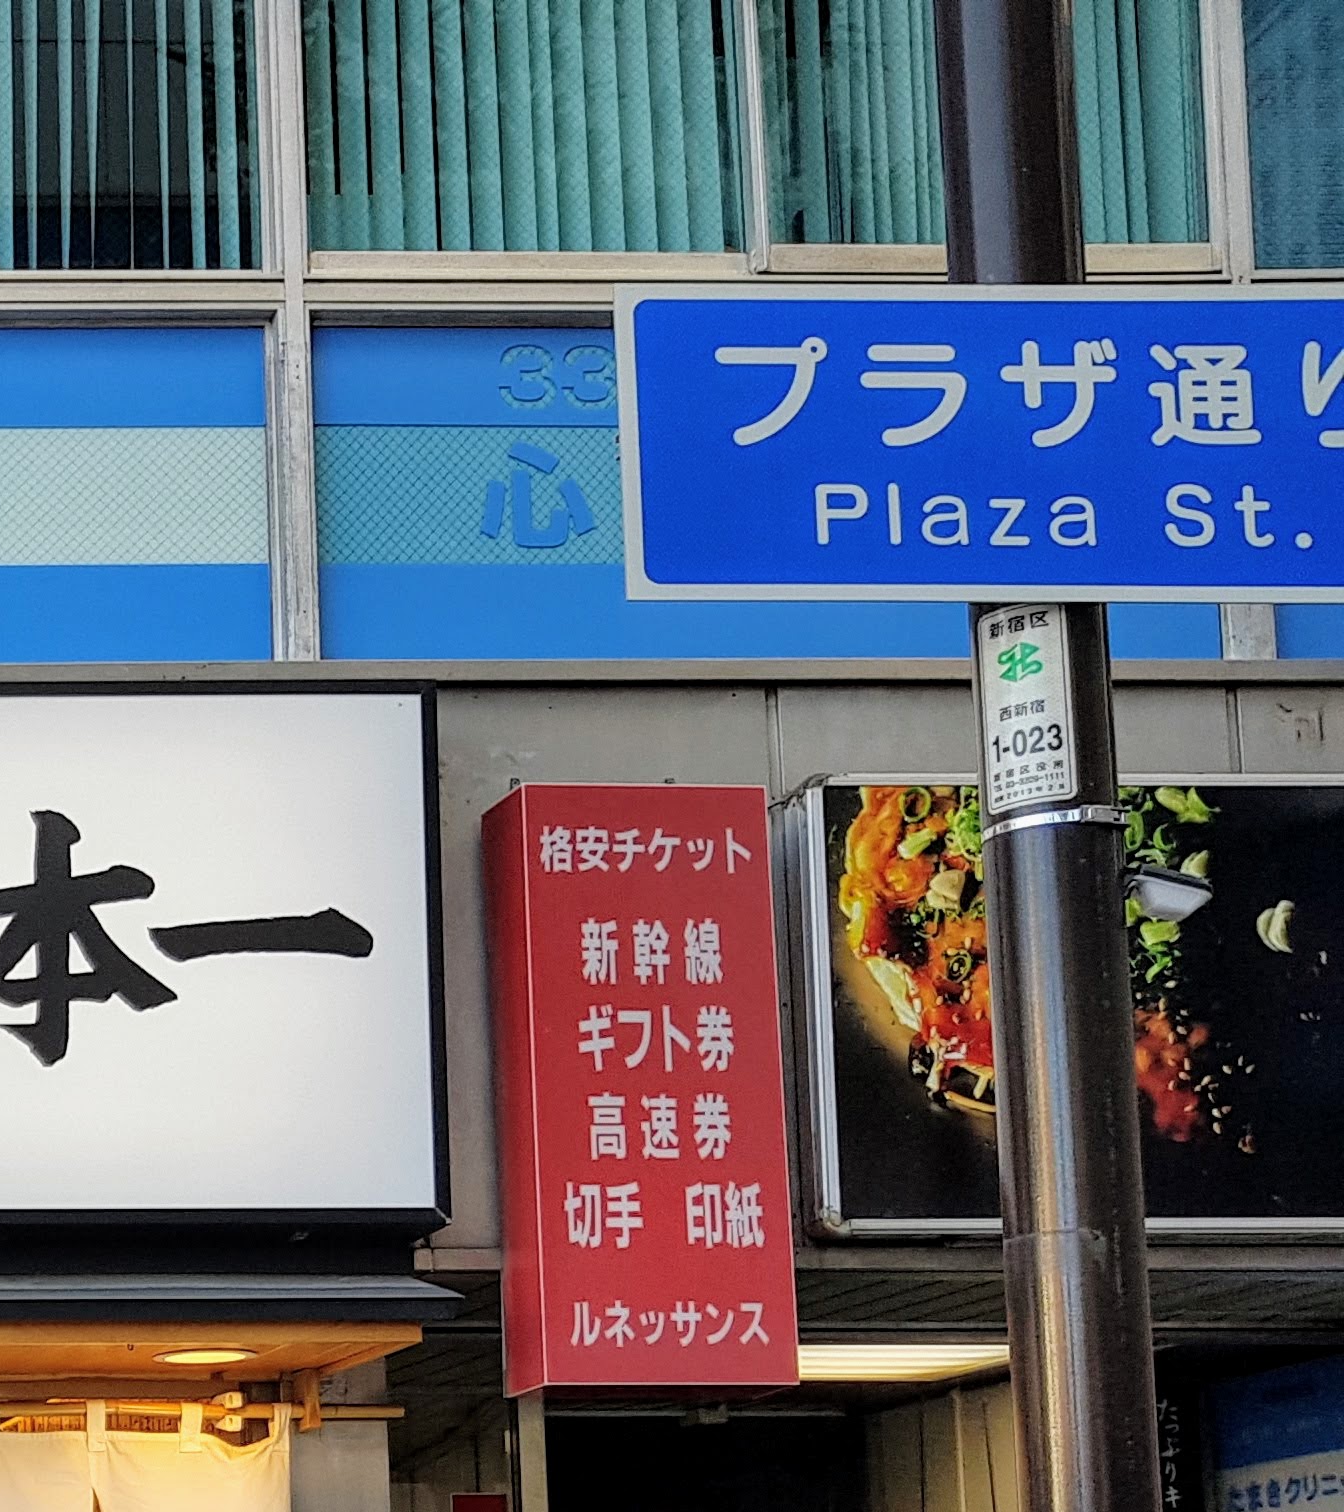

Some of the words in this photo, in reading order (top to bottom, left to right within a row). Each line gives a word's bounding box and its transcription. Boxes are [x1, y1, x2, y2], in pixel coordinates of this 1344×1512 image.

[814, 483, 1097, 548] Plaza
[1164, 483, 1314, 548] St.
[989, 611, 1049, 640] 新宿区
[999, 700, 1045, 722] 西新宿
[992, 723, 1063, 763] 1-023
[540, 825, 752, 874] 格安チケット
[580, 918, 723, 986] 新幹線
[577, 1005, 734, 1073] ギフト券
[588, 1092, 732, 1161] 高速券
[564, 1182, 643, 1249] 切手
[685, 1182, 764, 1249] 印紙
[570, 1301, 770, 1347] ルネッサンス
